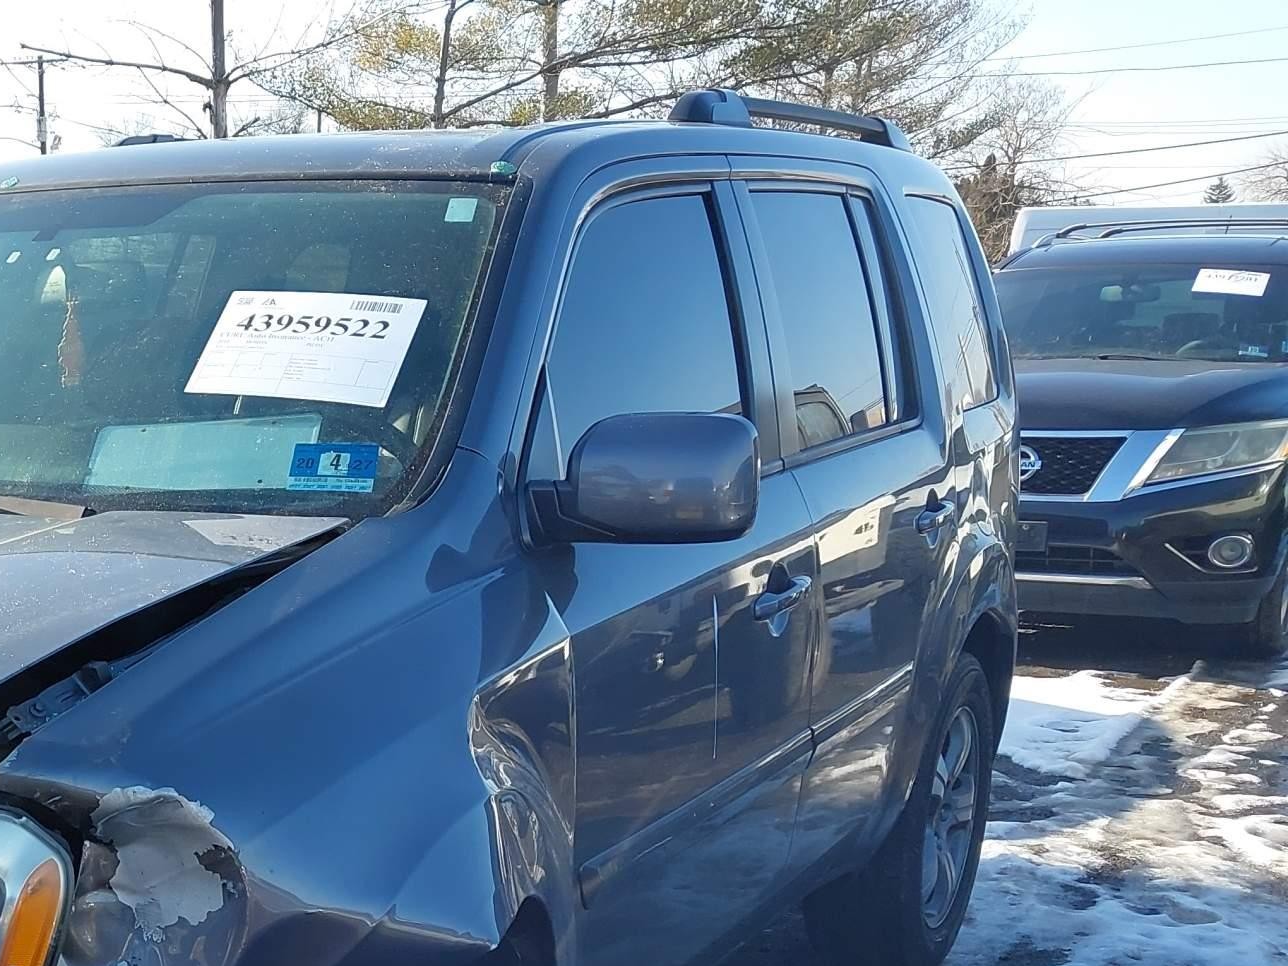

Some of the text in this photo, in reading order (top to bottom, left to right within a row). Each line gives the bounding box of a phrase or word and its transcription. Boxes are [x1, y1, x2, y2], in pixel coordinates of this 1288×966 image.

[236, 312, 391, 340] 43959522
[296, 453, 374, 471] 20 4 27
